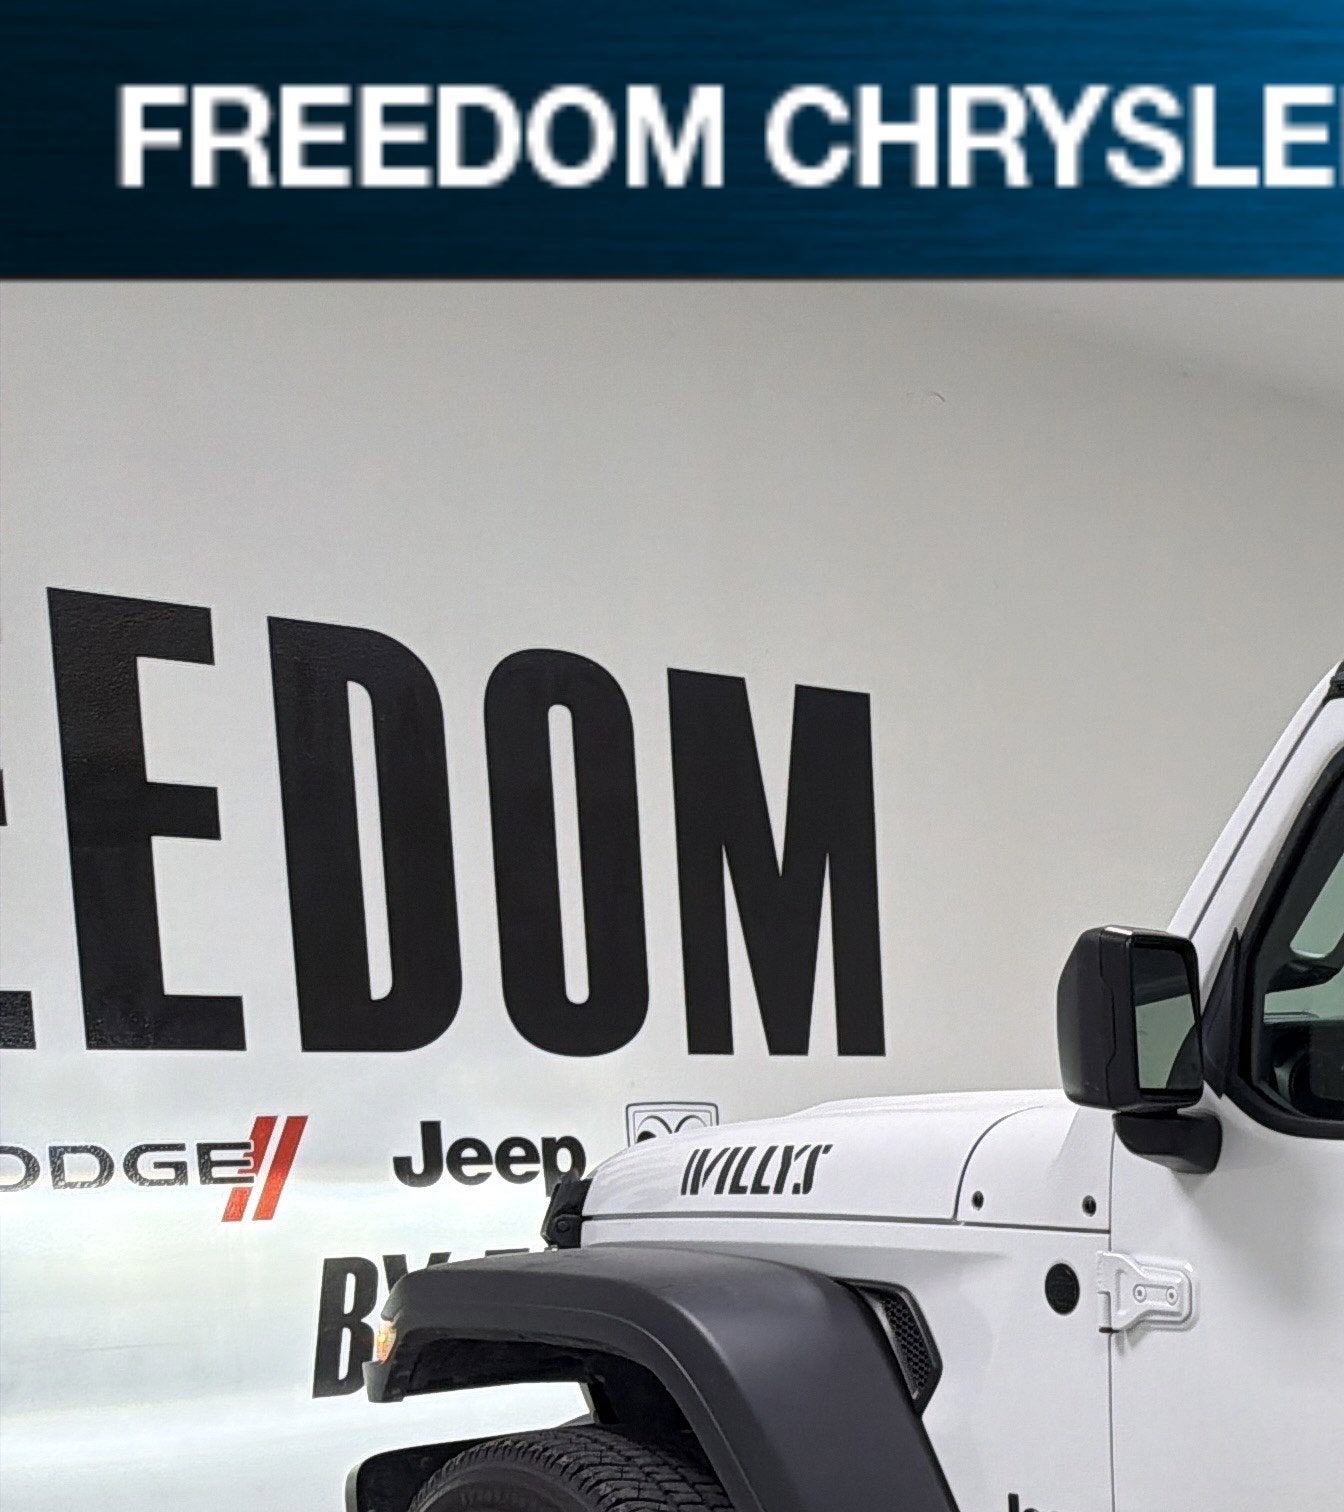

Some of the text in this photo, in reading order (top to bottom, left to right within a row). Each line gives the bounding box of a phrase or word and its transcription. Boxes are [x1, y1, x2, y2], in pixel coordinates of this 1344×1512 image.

[0, 587, 886, 1057] EDOM
[393, 1121, 587, 1197] Jeep
[680, 1144, 833, 1196] WILLYS
